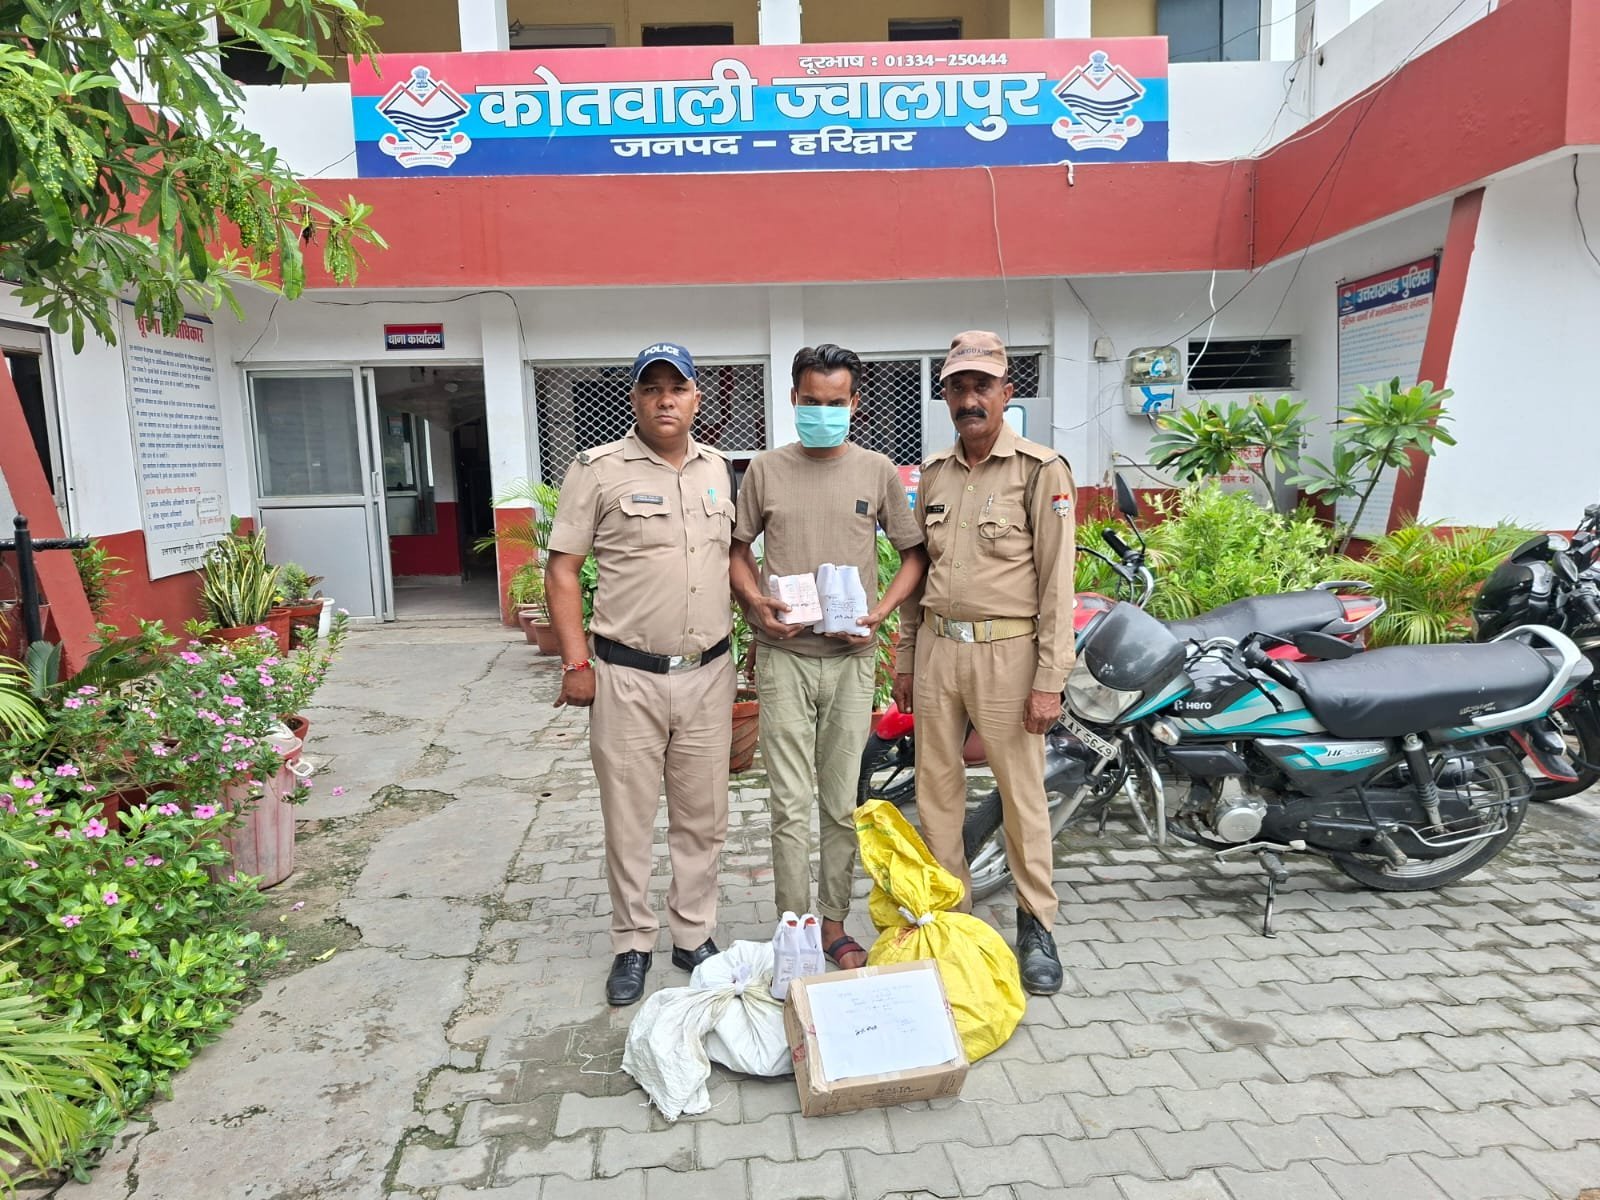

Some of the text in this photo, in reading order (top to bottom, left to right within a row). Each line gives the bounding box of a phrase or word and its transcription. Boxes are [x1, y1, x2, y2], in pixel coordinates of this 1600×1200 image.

[799, 54, 864, 75] दूरभाष
[885, 52, 1008, 68] 01334-250444
[475, 58, 1047, 142] कोतवाली ज्वालापुर
[610, 134, 743, 158] जनपद
[789, 125, 918, 155] हरिद्वार
[1357, 265, 1432, 303] उत्तराखण्ड पुलिस
[407, 329, 441, 345] कार्यालय
[644, 344, 680, 357] POLICE
[1068, 721, 1082, 735] AY
[1084, 733, 1112, 757] 5649
